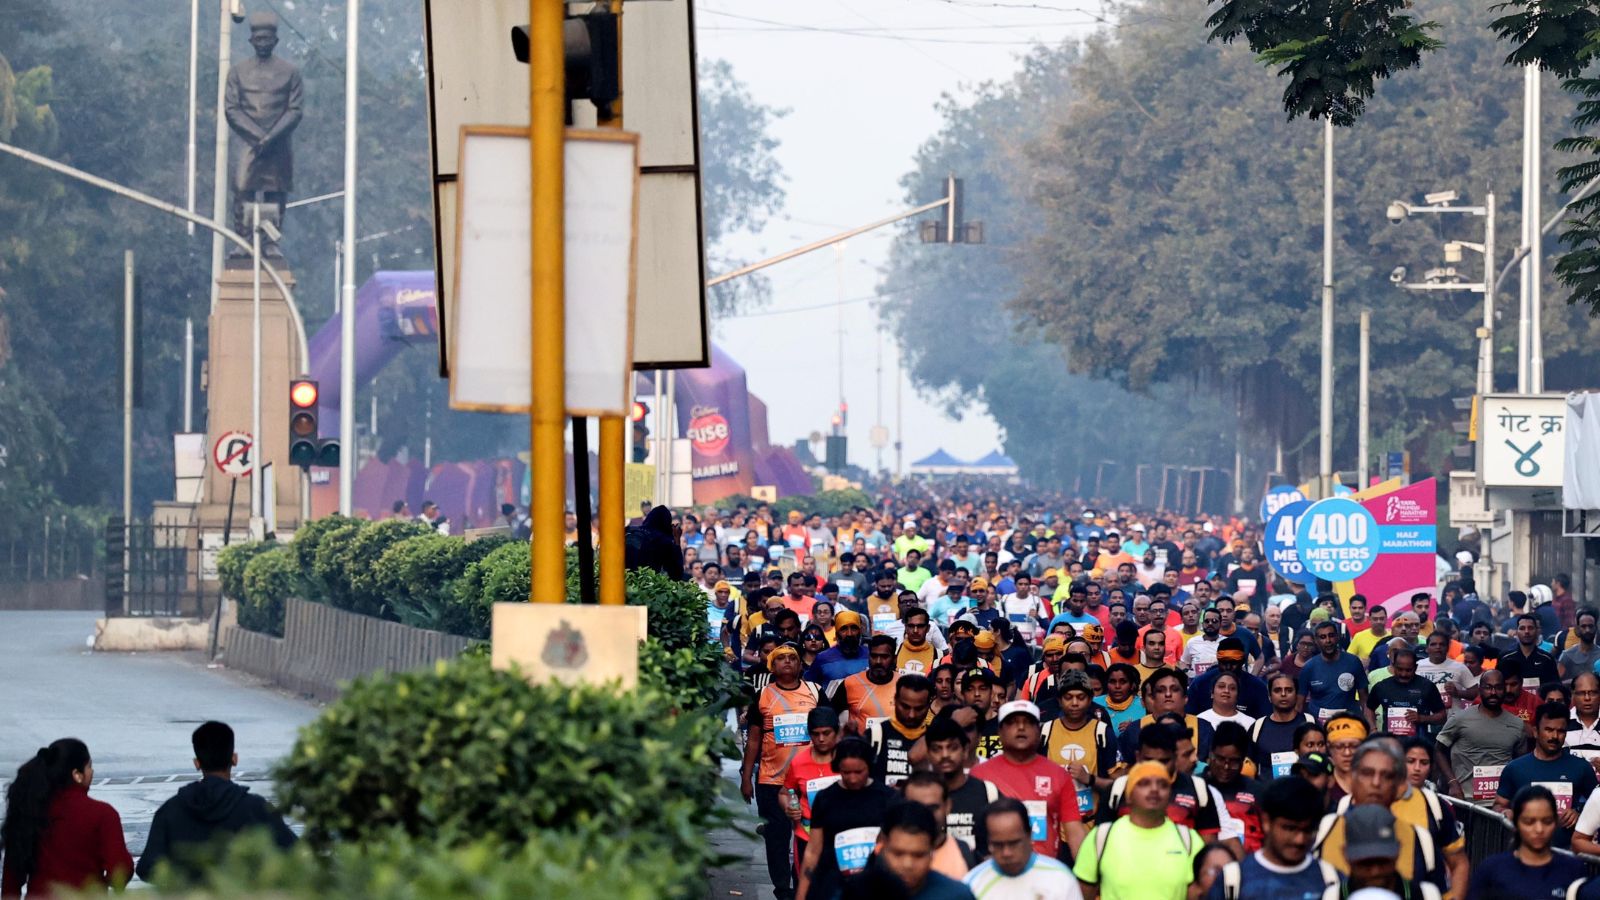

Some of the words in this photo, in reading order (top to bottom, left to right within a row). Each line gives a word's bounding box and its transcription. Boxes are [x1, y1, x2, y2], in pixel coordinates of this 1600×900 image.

[1497, 406, 1532, 432] गेट
[1275, 515, 1301, 547] 4
[1308, 513, 1367, 545] 400
[1396, 531, 1419, 539] HALF
[1306, 547, 1370, 560] METERS
[1280, 561, 1303, 574] TO
[1313, 560, 1336, 573] TO
[1339, 560, 1363, 573] GO
[780, 726, 805, 737] 53274
[887, 760, 908, 774] DONE
[1478, 781, 1499, 790] 2380
